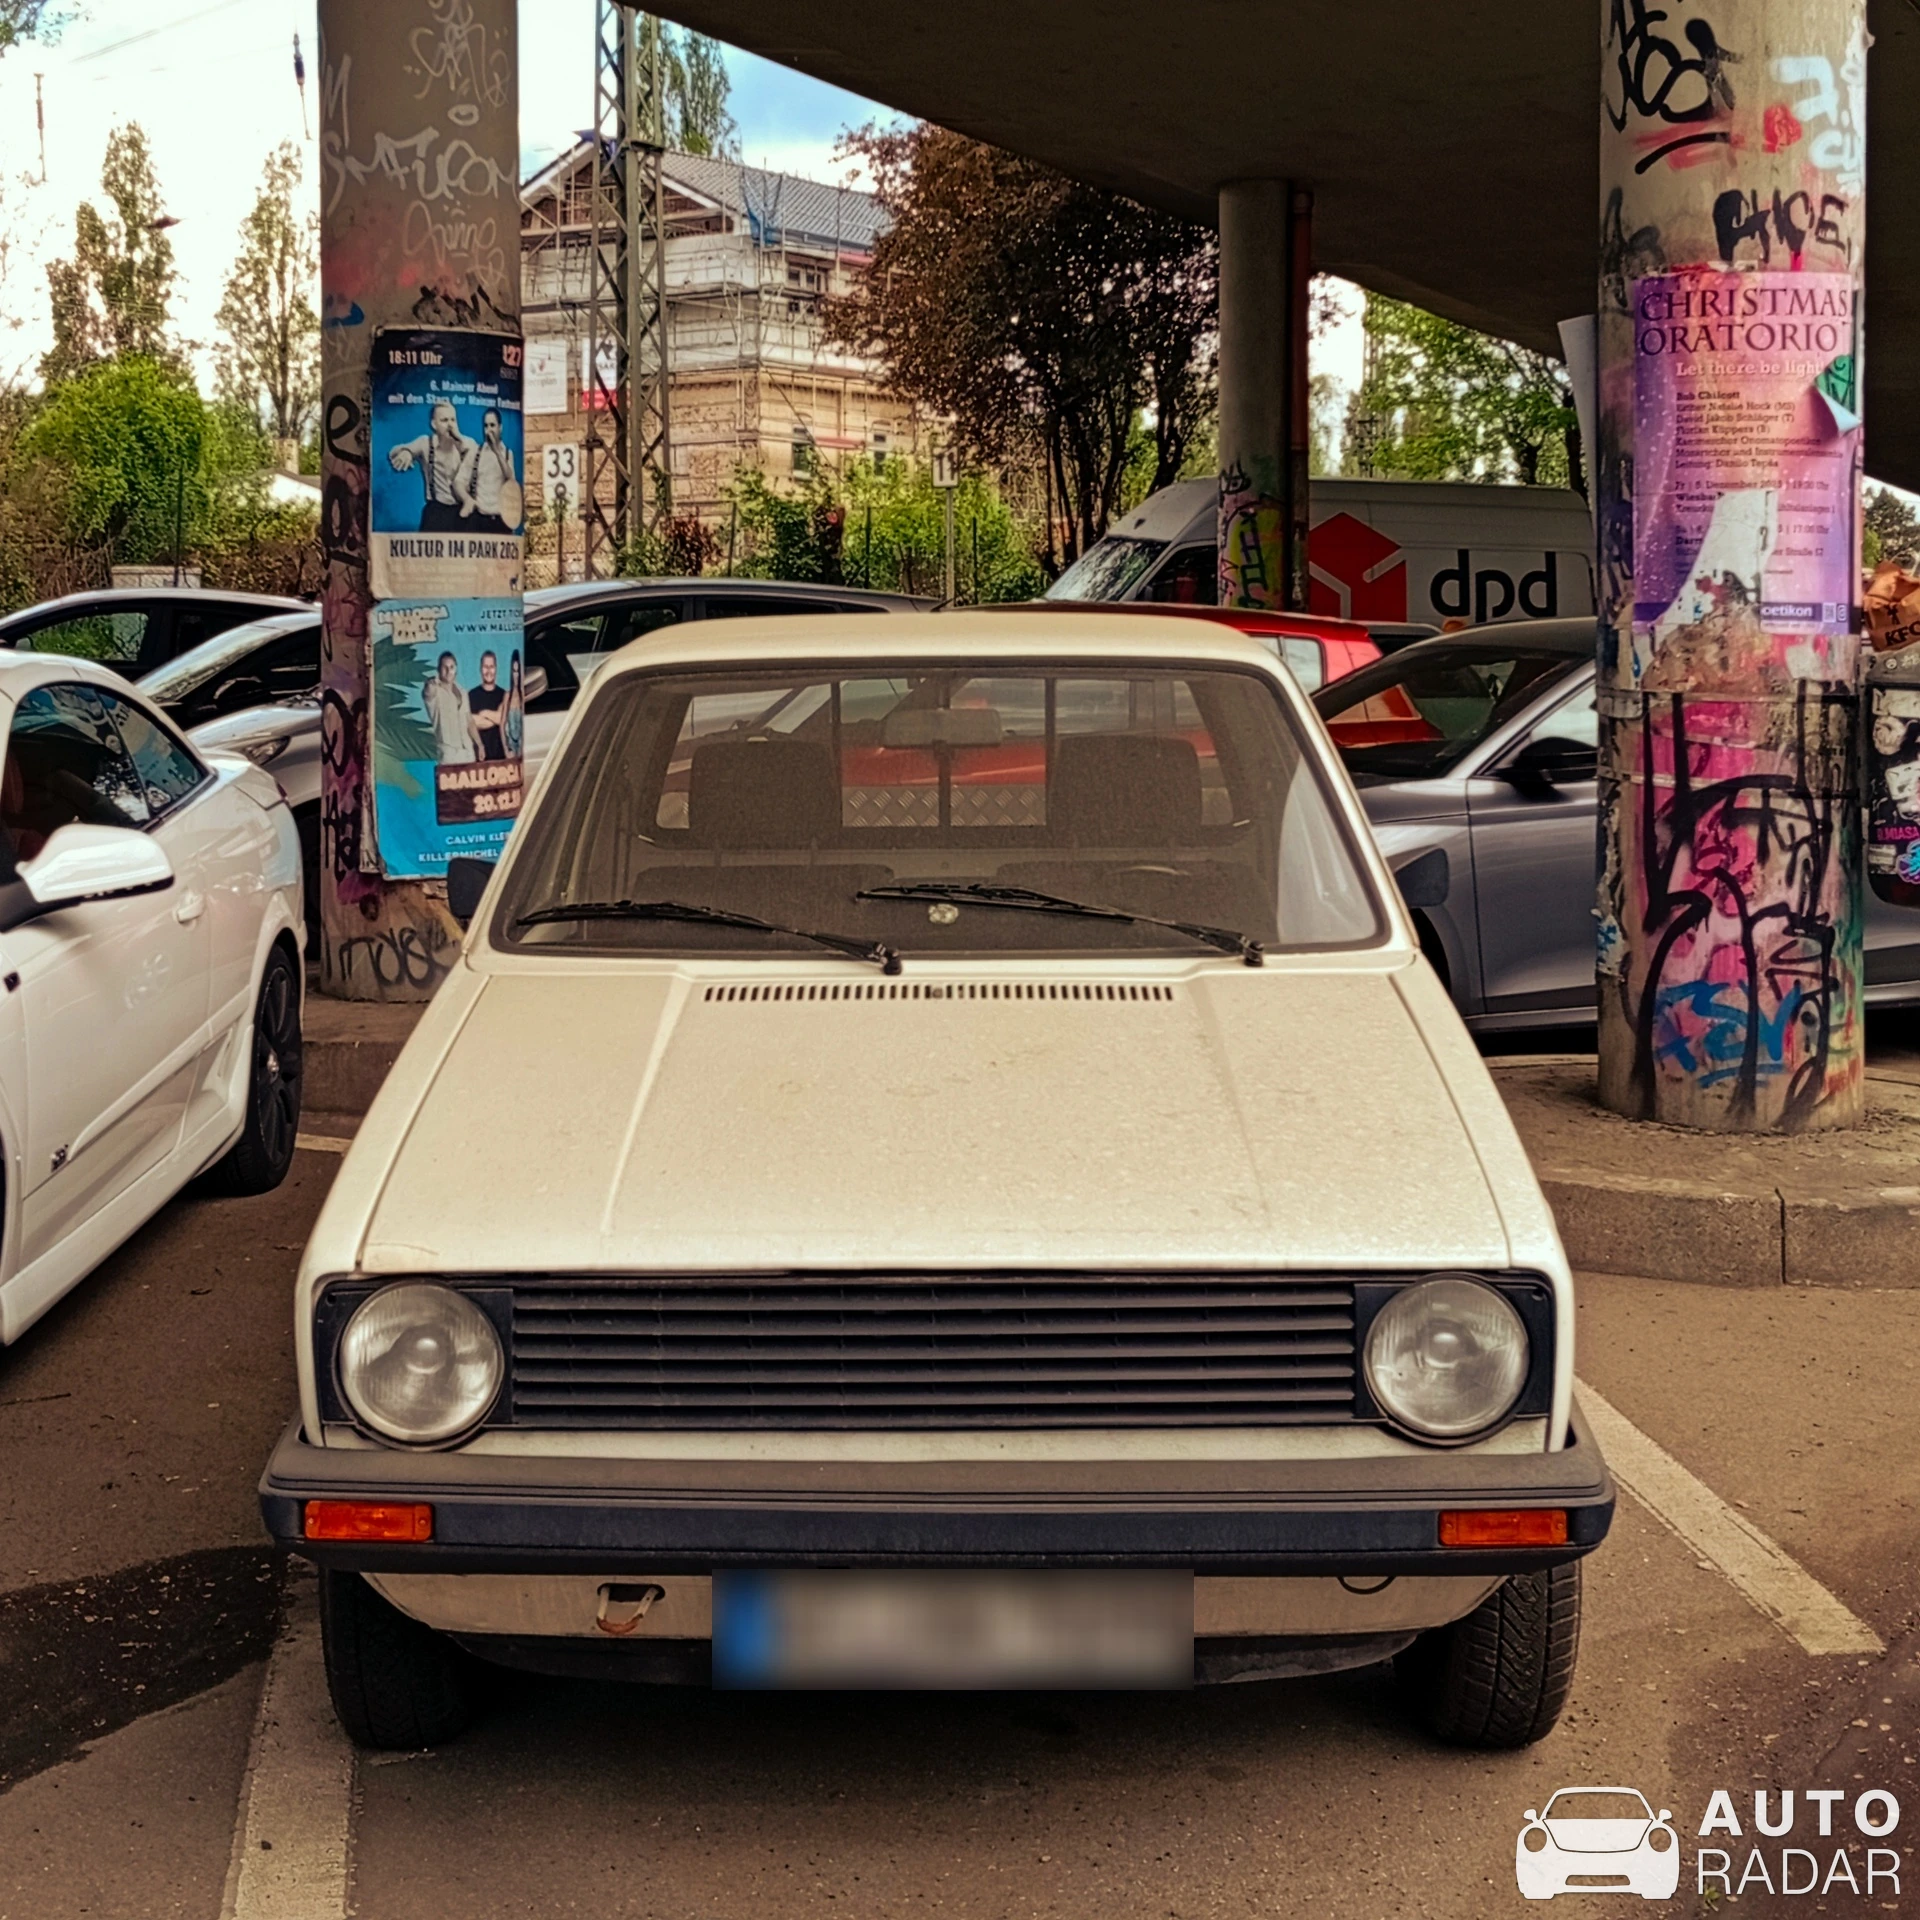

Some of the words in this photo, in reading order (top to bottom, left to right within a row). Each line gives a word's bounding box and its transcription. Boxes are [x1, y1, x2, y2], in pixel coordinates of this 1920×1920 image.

[1640, 288, 1848, 321] CHRISTMAS
[1639, 322, 1837, 356] ORATORIO
[420, 350, 443, 365] Uhr
[1676, 362, 1703, 377] Let
[1708, 360, 1757, 375] there
[1760, 360, 1782, 375] be
[1698, 391, 1740, 400] Chilcott
[547, 447, 575, 479] 33
[389, 539, 444, 558] KULTUR
[448, 540, 465, 558] IM
[468, 541, 499, 559] PARK
[1430, 549, 1557, 623] dpd
[481, 608, 507, 619] JETZT
[1760, 604, 1813, 617] oetikon
[1885, 620, 1920, 646] KFC
[445, 834, 486, 846] CALVIN
